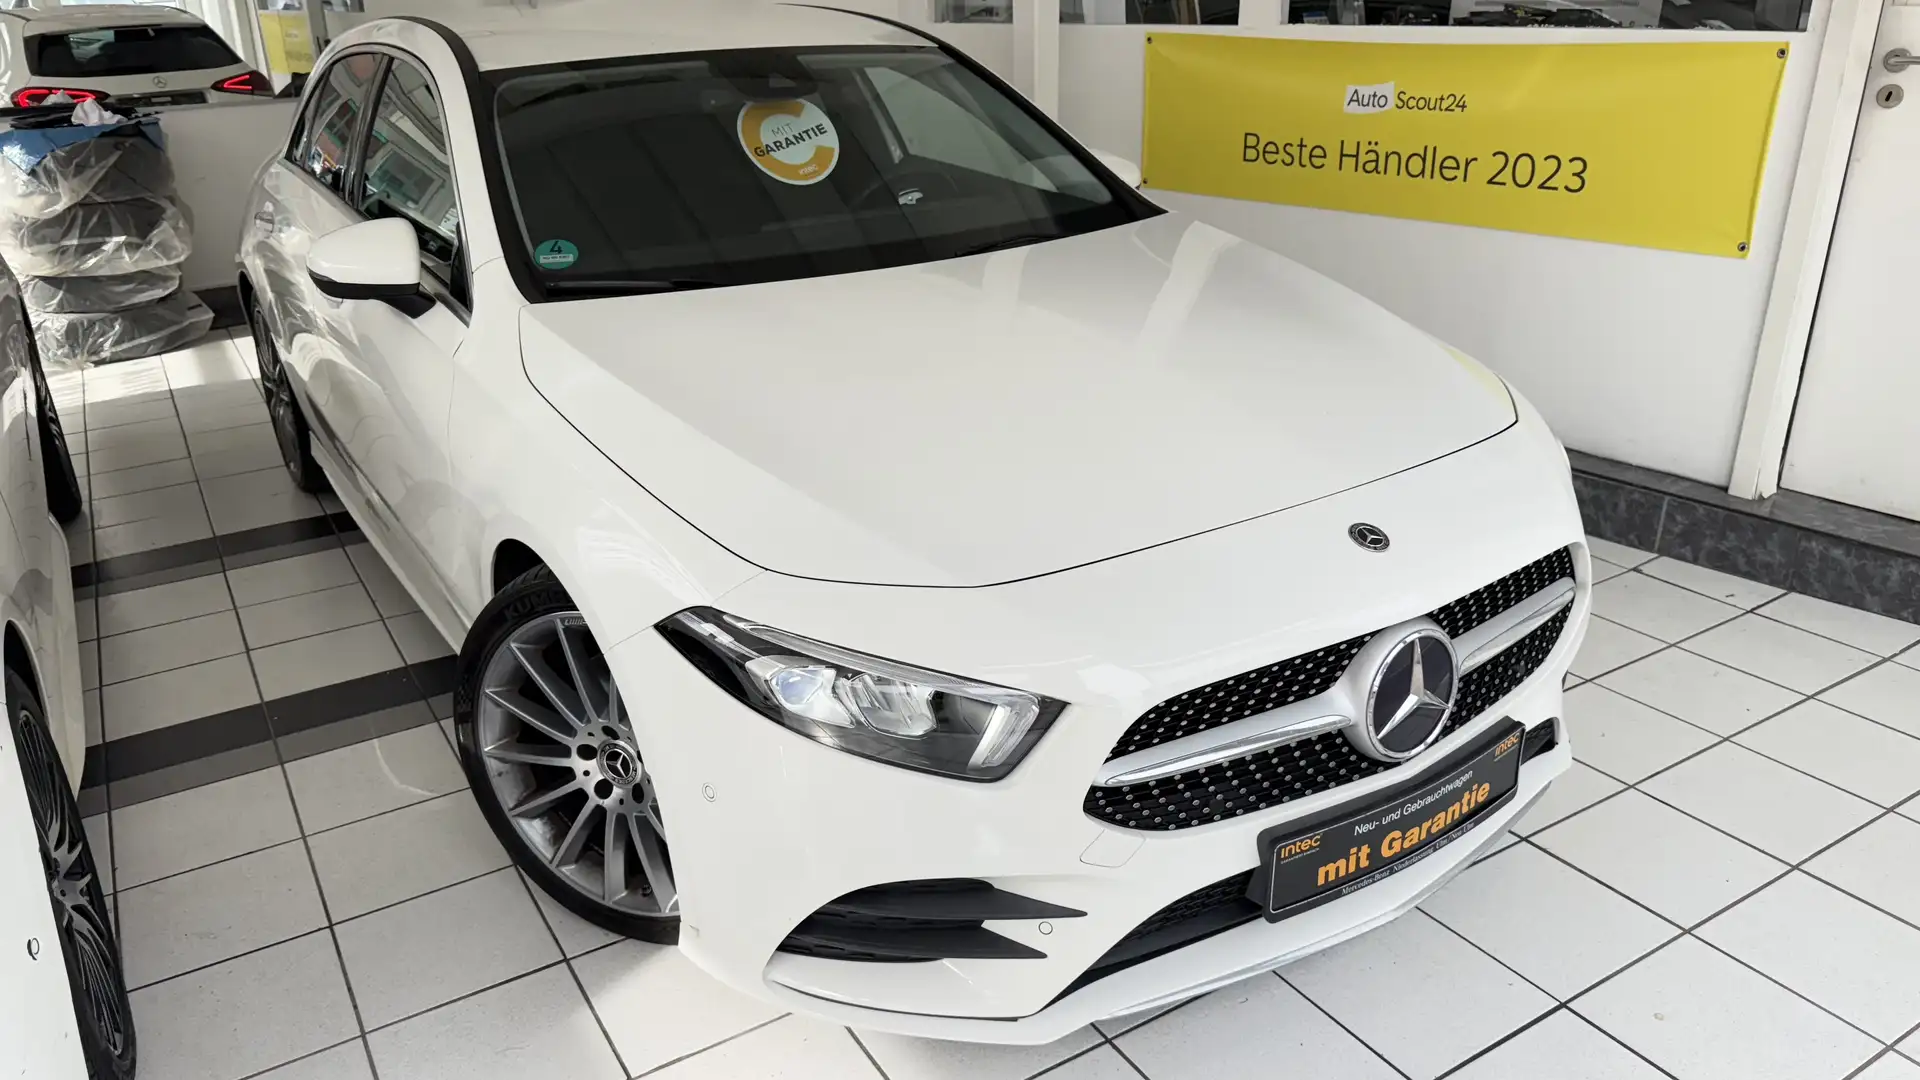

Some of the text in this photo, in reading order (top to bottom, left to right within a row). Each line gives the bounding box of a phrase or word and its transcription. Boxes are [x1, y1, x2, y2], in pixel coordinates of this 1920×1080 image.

[1347, 88, 1468, 113] Auto Scout24
[753, 122, 828, 158] GARANTIE
[771, 122, 795, 138] MIT
[1242, 132, 1588, 194] Beste Händler 2023
[549, 240, 564, 254] 4
[1354, 769, 1474, 836] Neu- und Gebrauchtwagen
[1280, 834, 1321, 859] intec
[1317, 782, 1491, 887] mit Garantie
